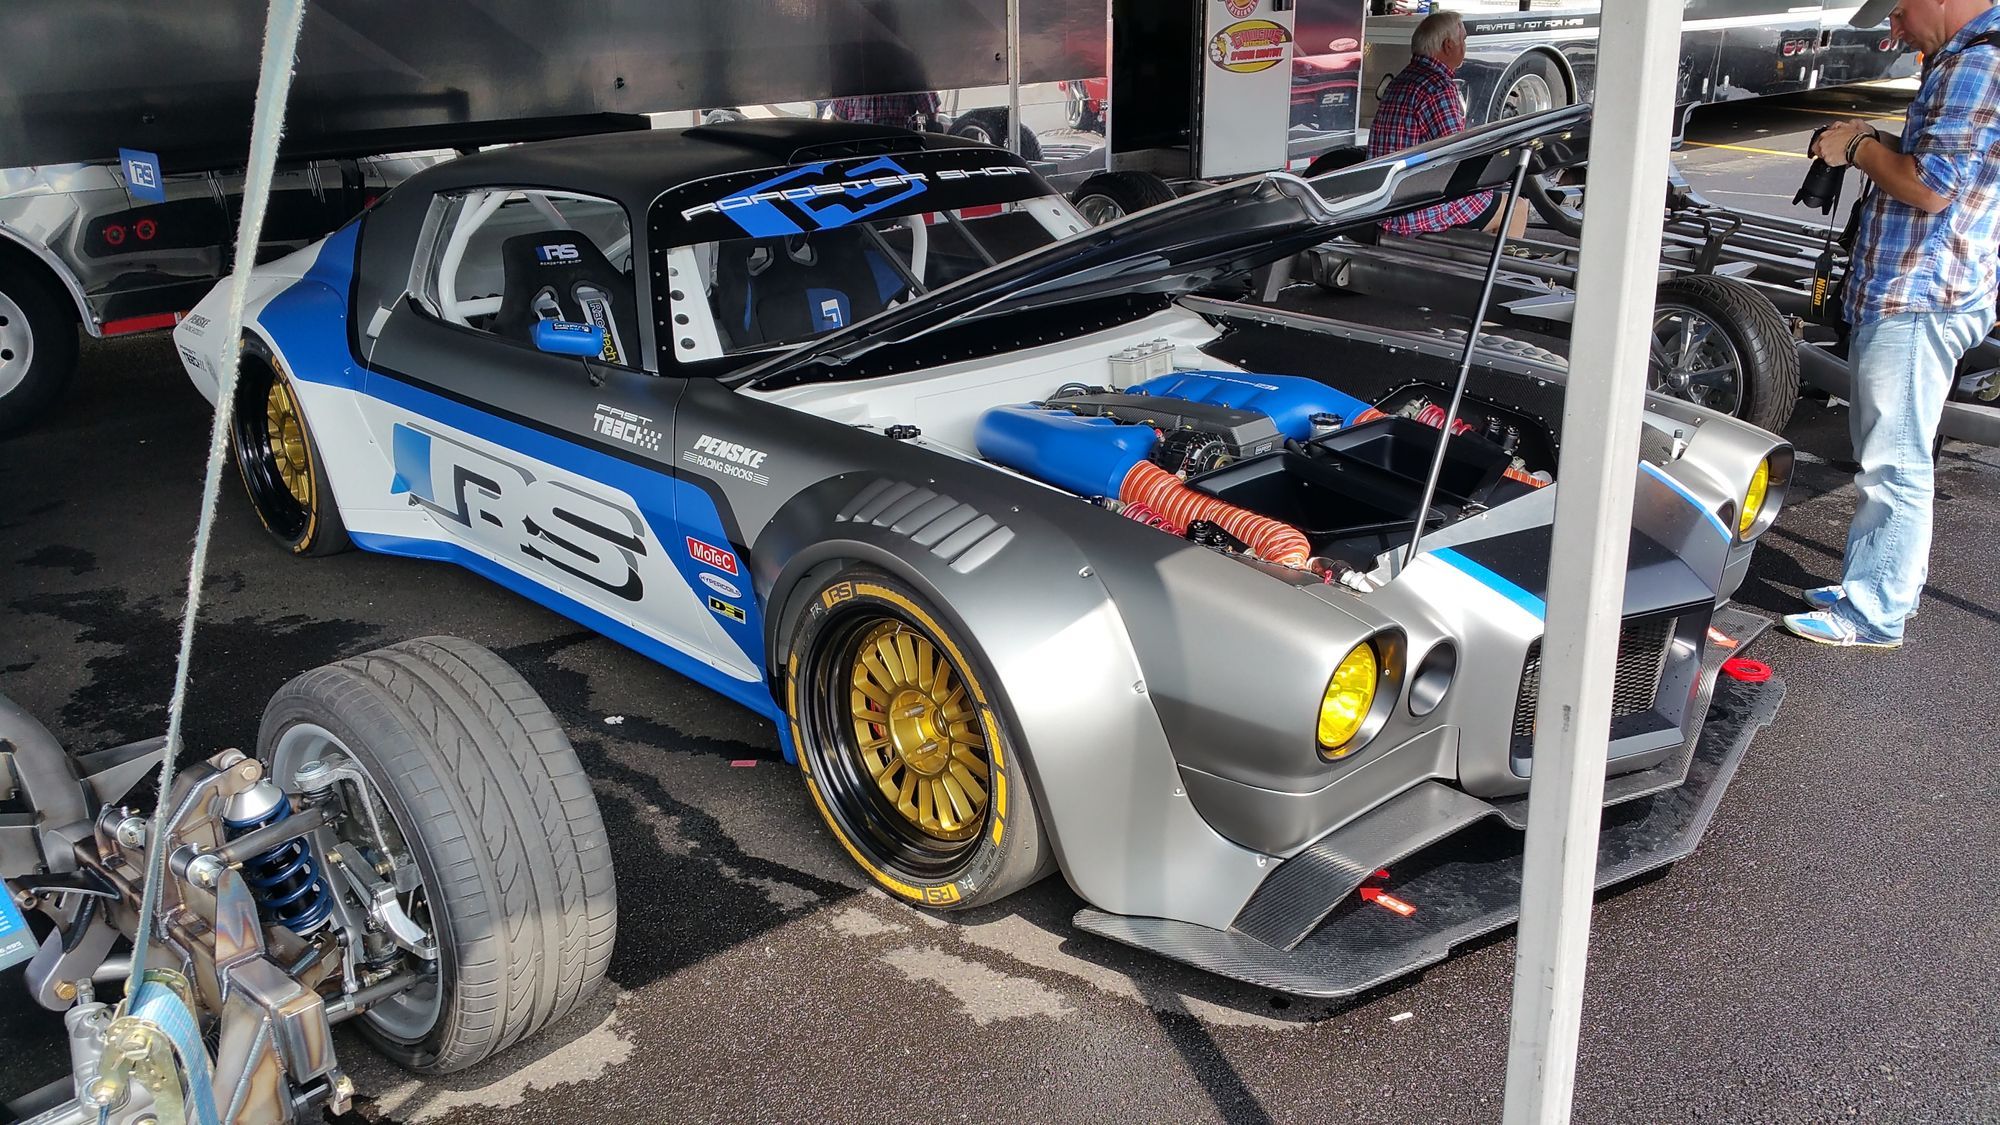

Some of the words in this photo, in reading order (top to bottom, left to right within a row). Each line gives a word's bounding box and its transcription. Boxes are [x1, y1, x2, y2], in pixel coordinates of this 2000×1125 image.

[1475, 22, 1516, 32] PRIVATE
[1523, 20, 1543, 28] NOT
[1544, 19, 1564, 28] FOR
[680, 172, 930, 222] ROADSTER
[935, 165, 1031, 180] SHOP
[541, 243, 579, 260] RS
[1813, 277, 1827, 306] Nikon
[596, 403, 653, 425] FAST
[693, 433, 768, 469] PENSKE
[696, 454, 724, 473] RACING
[723, 462, 754, 482] SHOCKS
[693, 542, 731, 570] MoTeC
[827, 582, 852, 604] RS
[928, 886, 954, 904] RS
